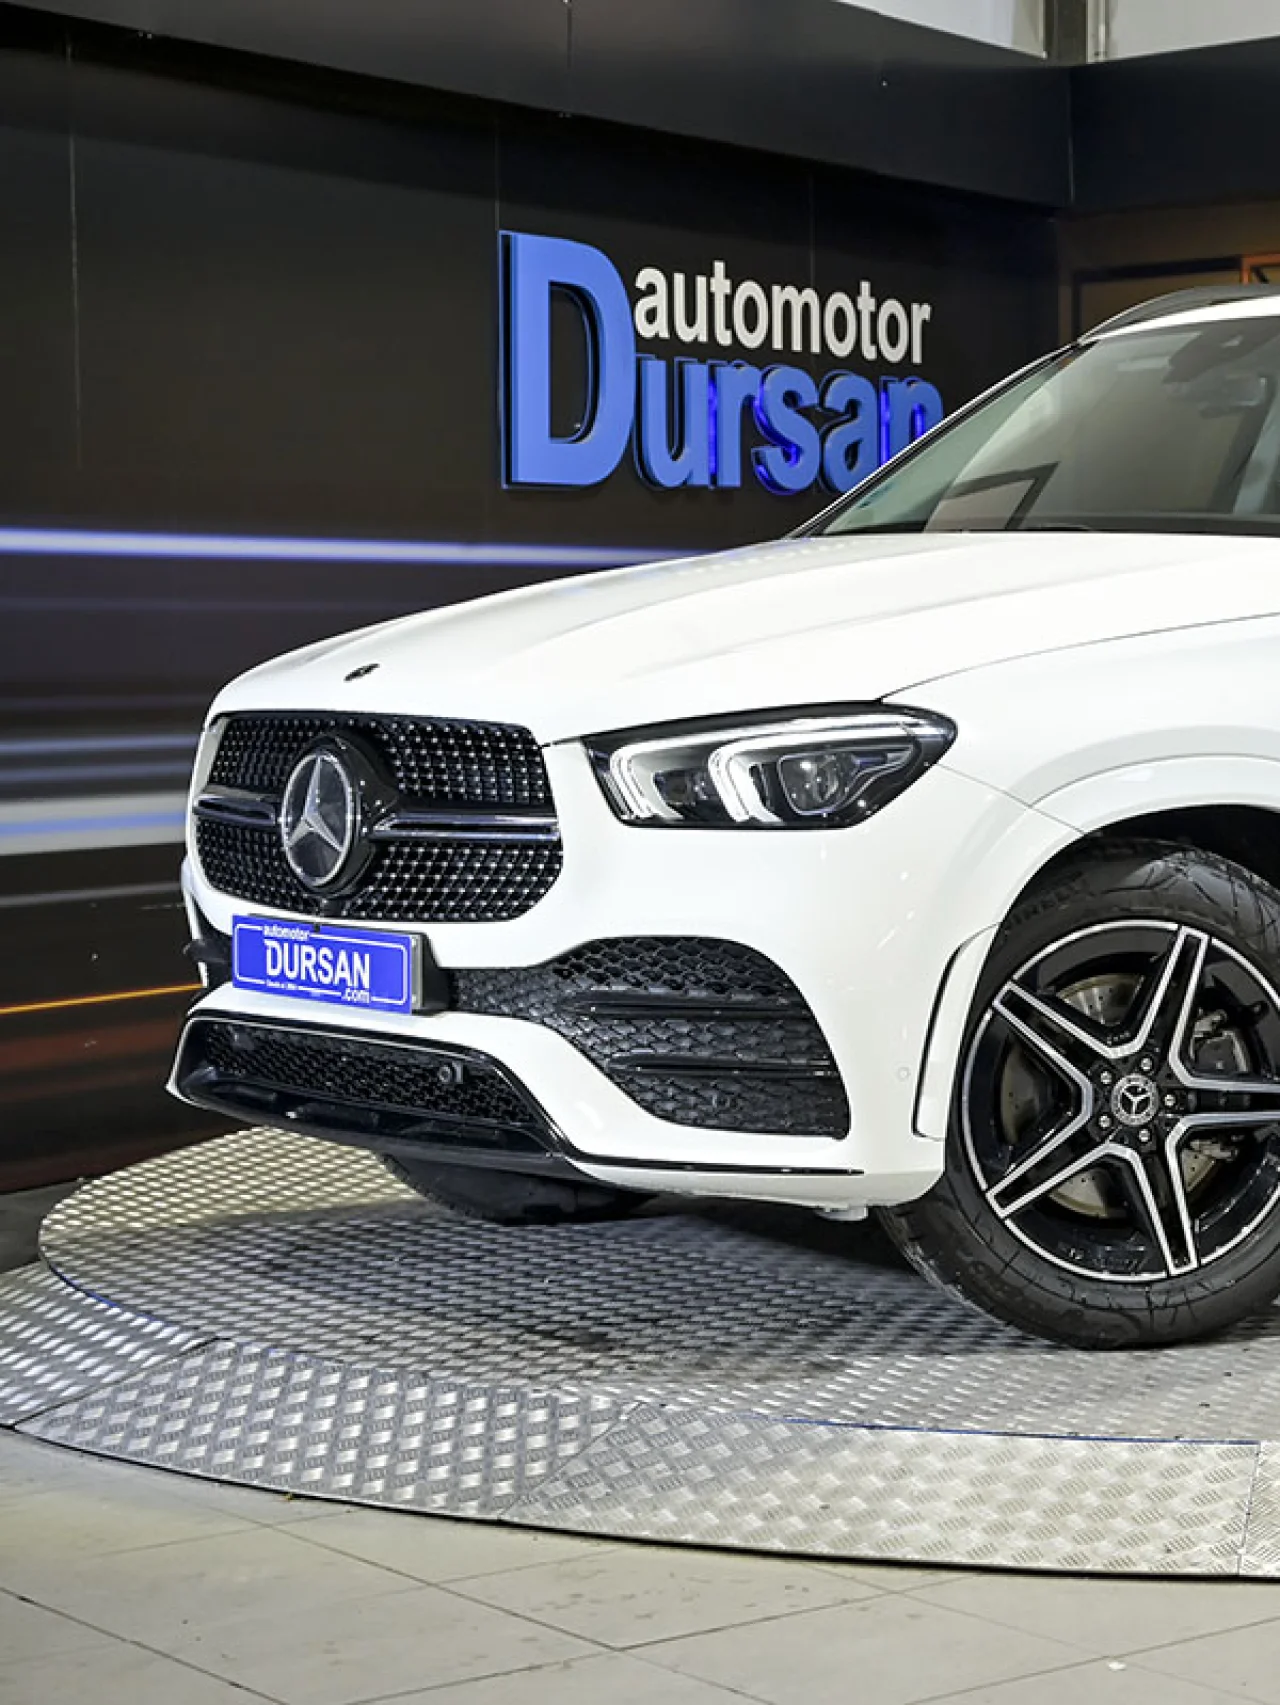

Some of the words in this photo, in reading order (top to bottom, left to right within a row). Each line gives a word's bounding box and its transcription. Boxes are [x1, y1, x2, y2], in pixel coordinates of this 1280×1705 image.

[499, 229, 943, 494] Dursan
[634, 260, 931, 364] automotor
[264, 938, 370, 989] DURSAN
